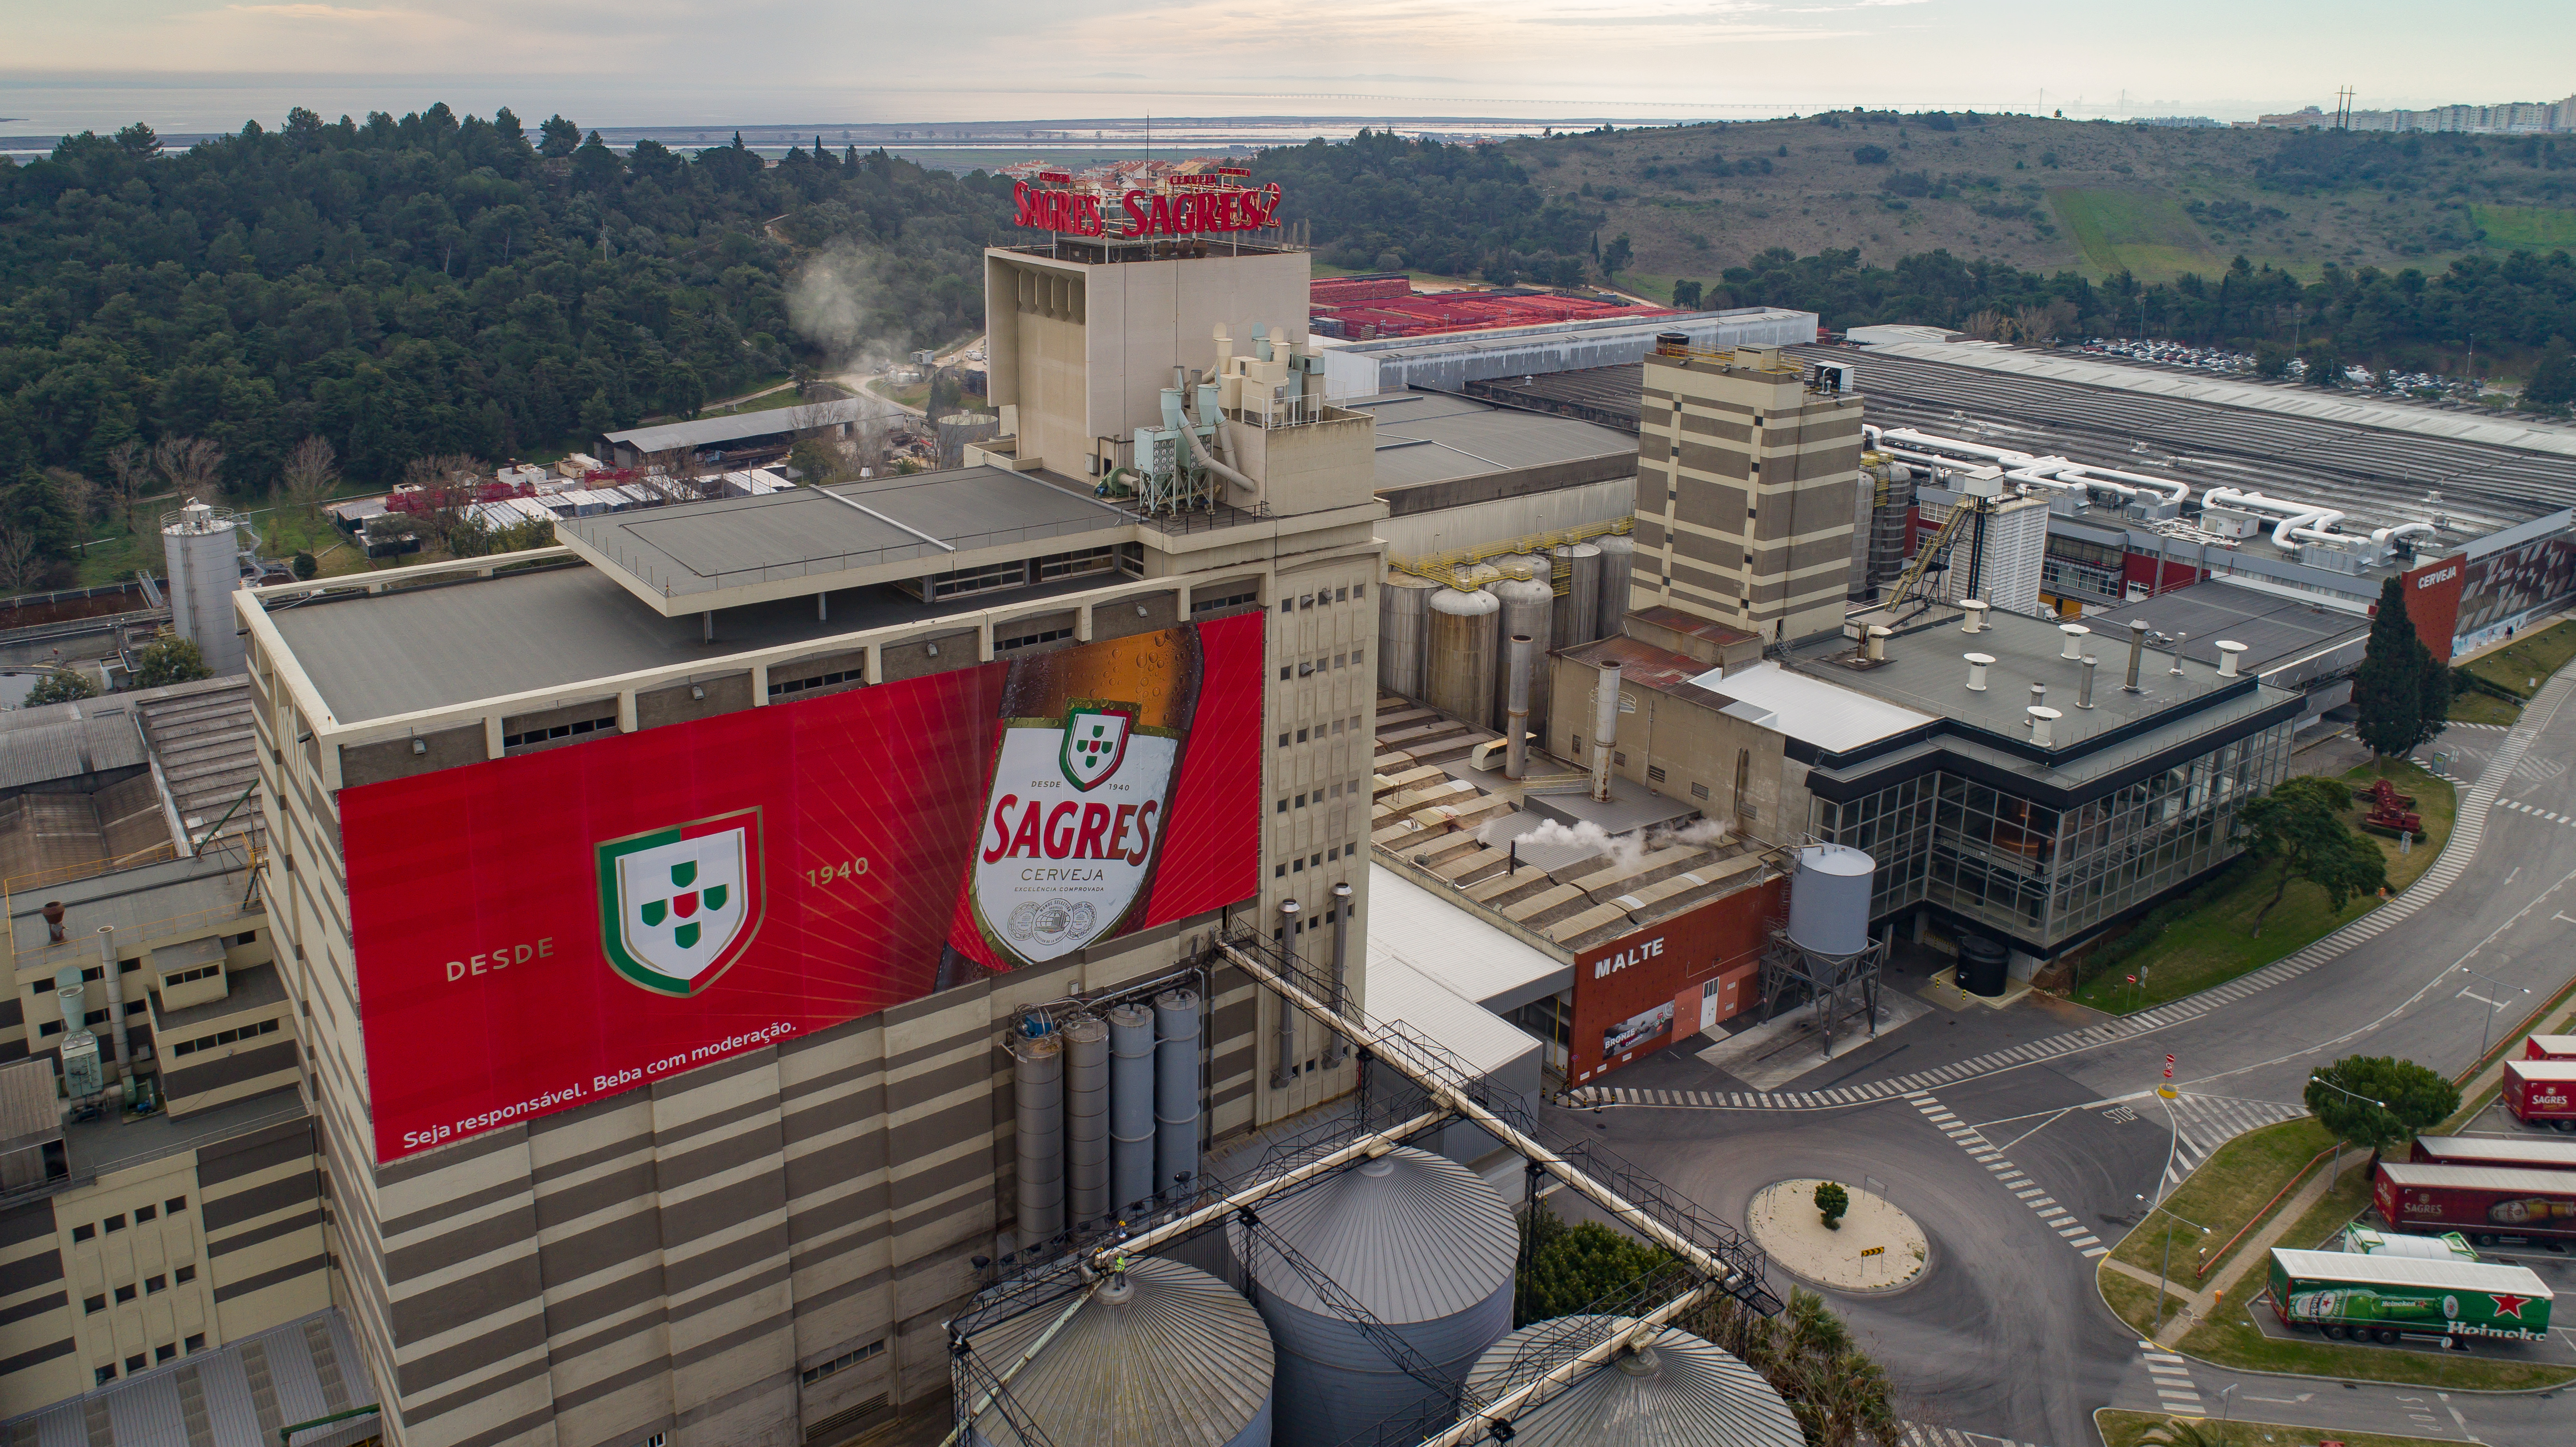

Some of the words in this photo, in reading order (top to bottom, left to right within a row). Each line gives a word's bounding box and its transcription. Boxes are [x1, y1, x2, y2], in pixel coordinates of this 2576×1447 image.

[1170, 174, 1217, 185] CERVEJA
[1014, 181, 1102, 237] SAGRES
[1123, 190, 1261, 236] SAGRES
[2418, 566, 2457, 589] CERVEJA
[983, 794, 1159, 867] SAGRES
[806, 857, 869, 888] 1940
[1021, 869, 1104, 881] CERVEJA
[446, 937, 554, 982] DESDE
[1594, 937, 1664, 979] MALTE
[1605, 1028, 1635, 1049] BRONZE
[403, 1124, 451, 1149] Seja
[455, 1088, 589, 1133] responsável.
[593, 1066, 643, 1092] Beba
[646, 1052, 687, 1073] com
[690, 1021, 797, 1062] moderação.
[2532, 1094, 2568, 1104] SAGRES
[2102, 1106, 2138, 1124] STOP
[2404, 1203, 2442, 1214] SAGRES
